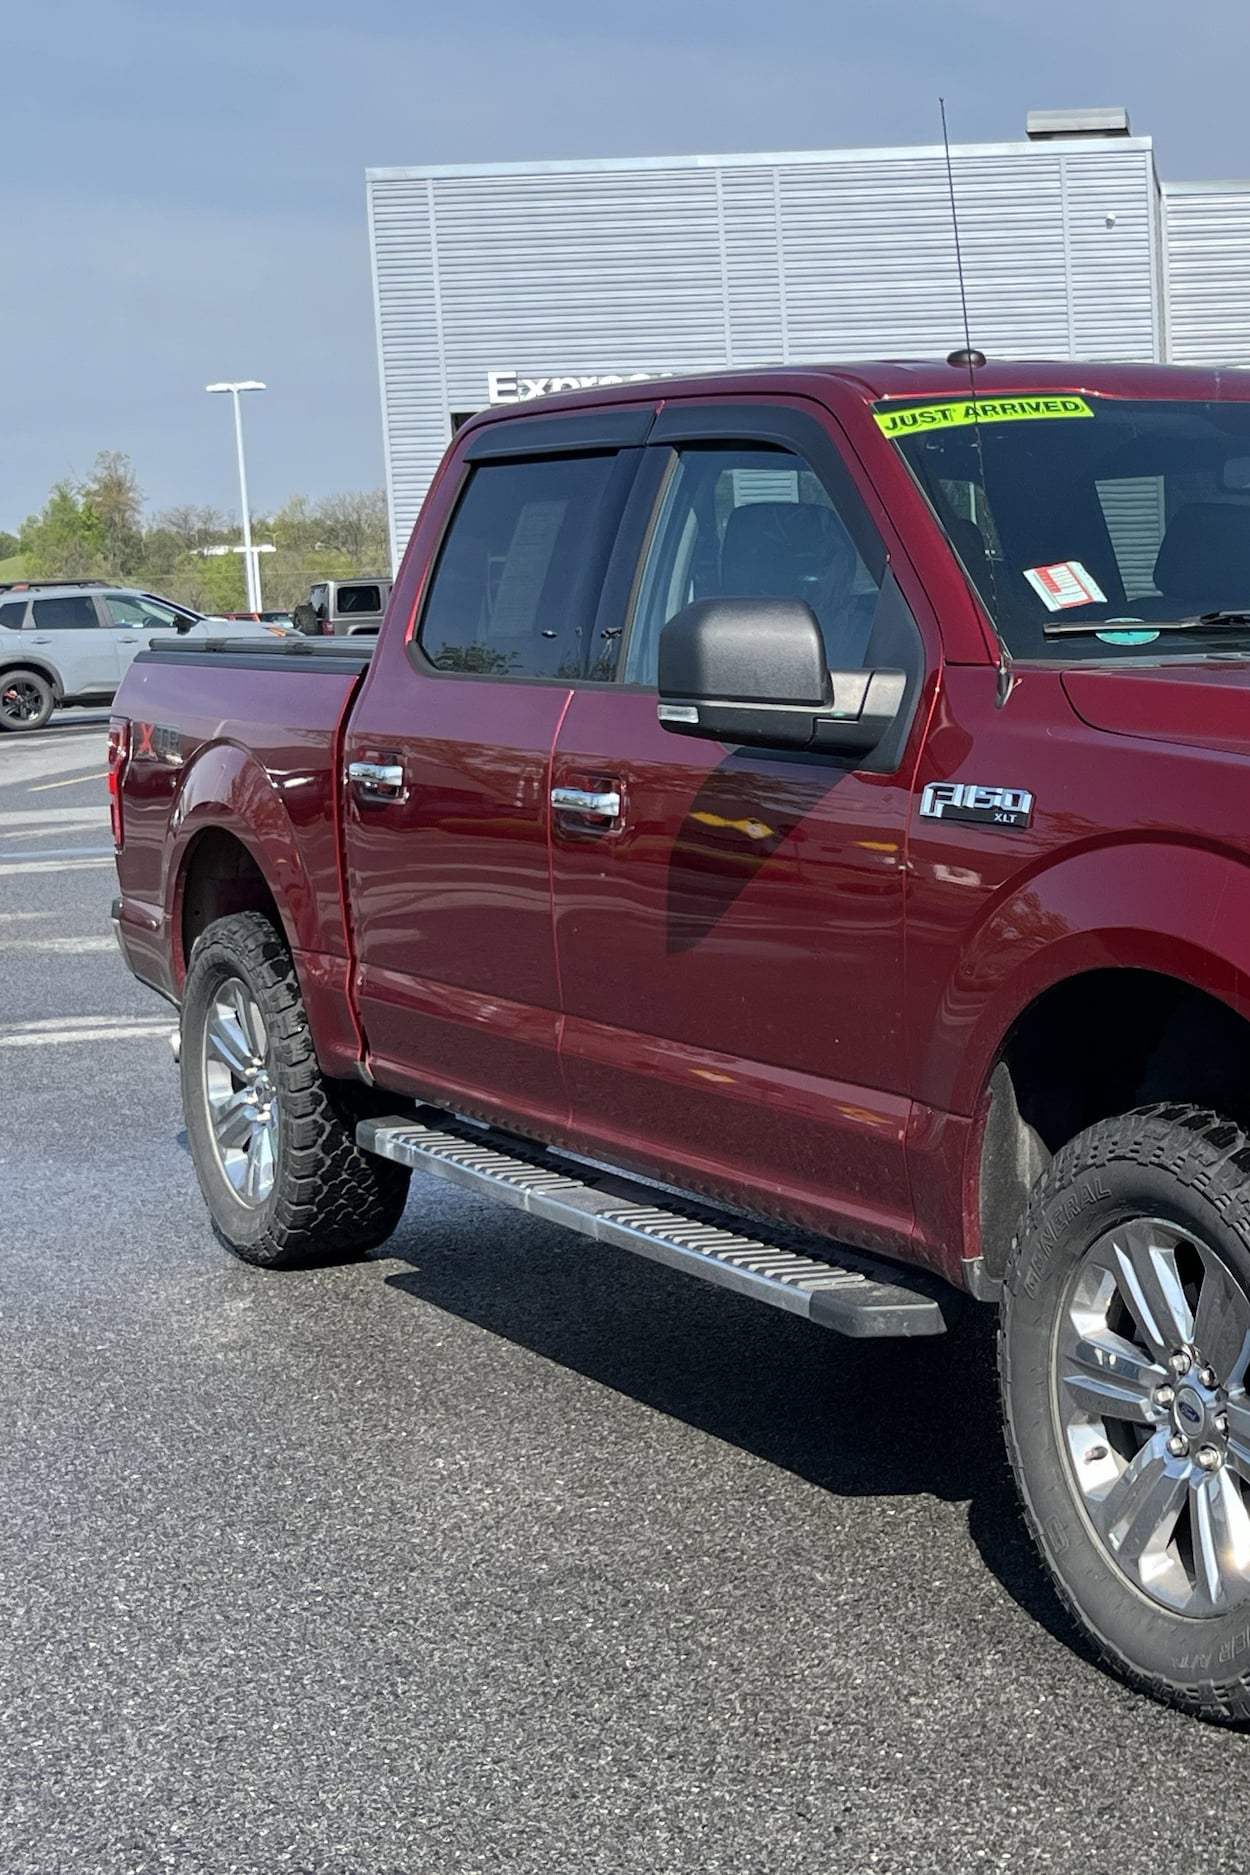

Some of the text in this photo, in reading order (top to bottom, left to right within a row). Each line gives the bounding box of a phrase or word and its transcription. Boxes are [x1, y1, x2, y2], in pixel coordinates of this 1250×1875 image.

[884, 399, 1085, 430] JUST ARRIVED
[994, 812, 1018, 824] XLT
